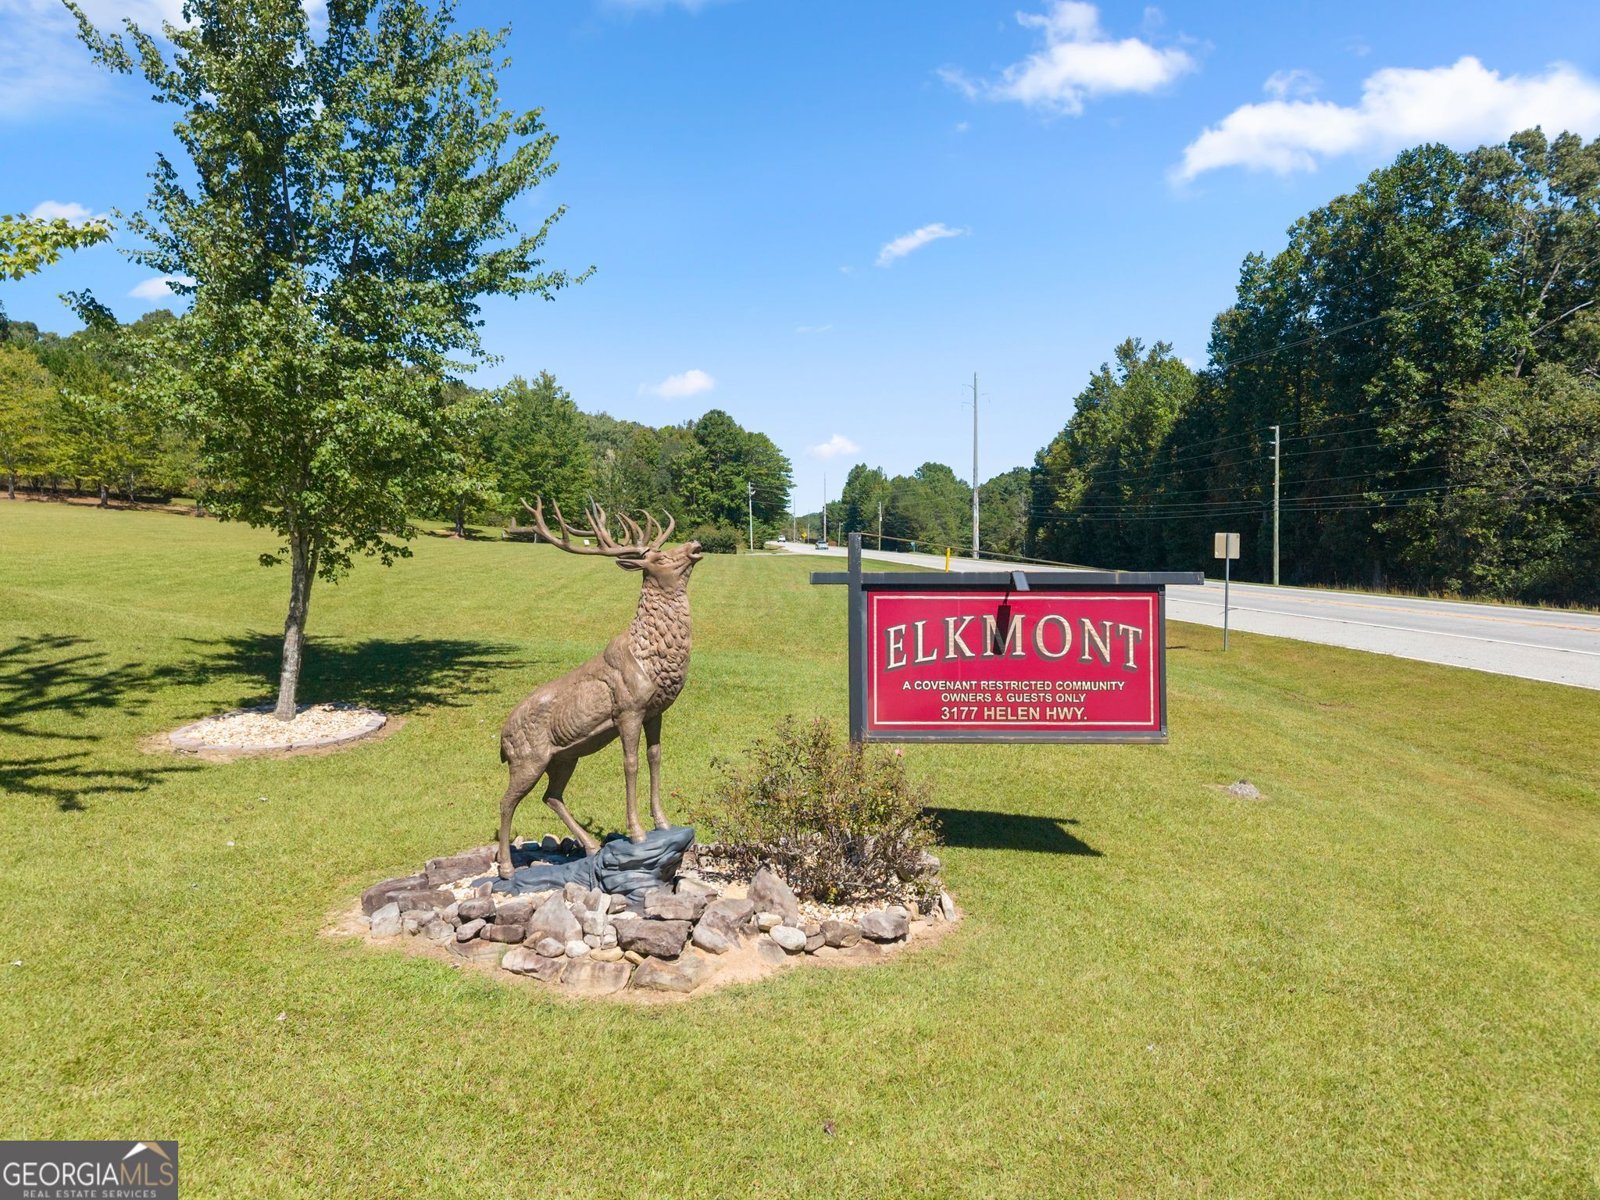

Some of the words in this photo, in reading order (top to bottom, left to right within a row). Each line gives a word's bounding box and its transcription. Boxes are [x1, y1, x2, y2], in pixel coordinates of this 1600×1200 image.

[886, 613, 1143, 670] ELKMONT
[902, 680, 911, 691] A
[914, 680, 977, 691] COVENANT
[981, 680, 1052, 691] RESTRICTED
[1056, 680, 1125, 691] COMMUNITY
[941, 693, 992, 703] OWNERS
[995, 693, 1003, 703] &
[1006, 693, 1052, 703] GUESTS
[1056, 693, 1087, 703] ONLY
[941, 706, 977, 721] 3177
[983, 706, 1041, 721] HELEN
[1046, 706, 1088, 721] HWY.
